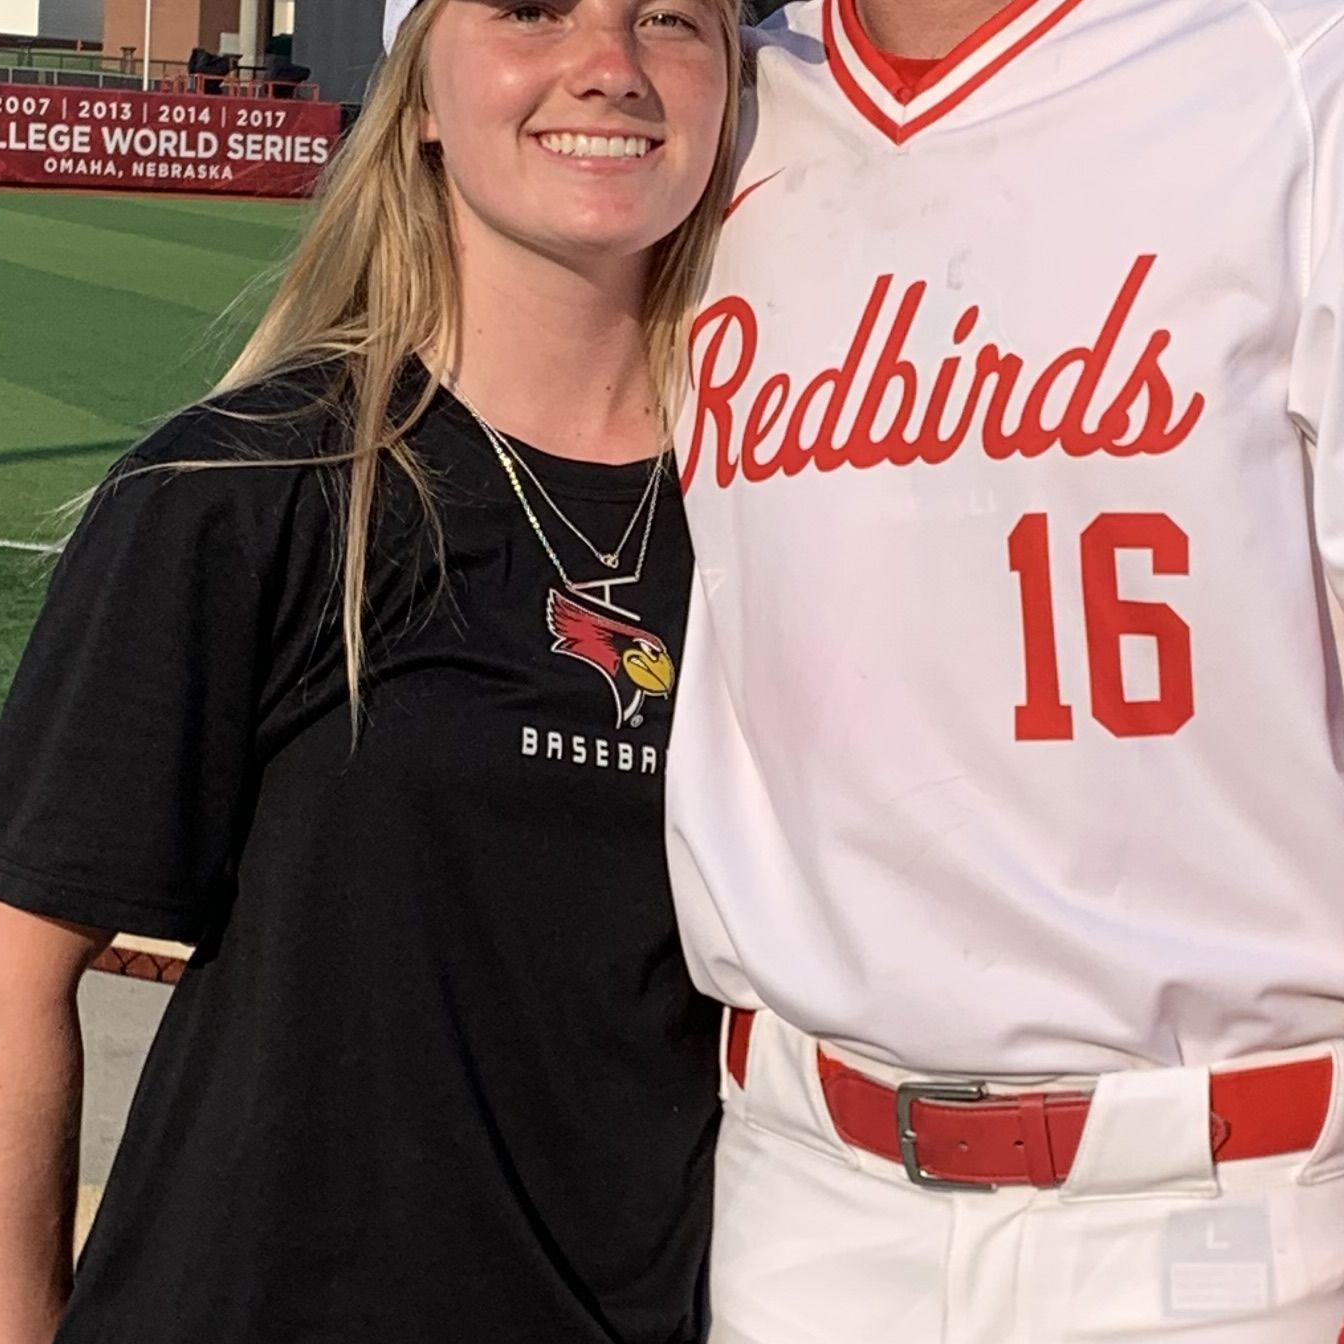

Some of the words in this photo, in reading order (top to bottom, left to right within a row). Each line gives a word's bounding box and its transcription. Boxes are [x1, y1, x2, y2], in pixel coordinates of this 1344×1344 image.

[78, 101, 132, 121] 2013
[158, 105, 211, 124] 2014
[236, 109, 286, 128] 2017
[101, 126, 218, 159] WORLD
[226, 133, 329, 164] SERIES
[44, 158, 124, 178] OMAHA,
[131, 161, 233, 180] NEBRASKA
[682, 253, 1205, 497] Redbirds
[1007, 512, 1195, 742] 16
